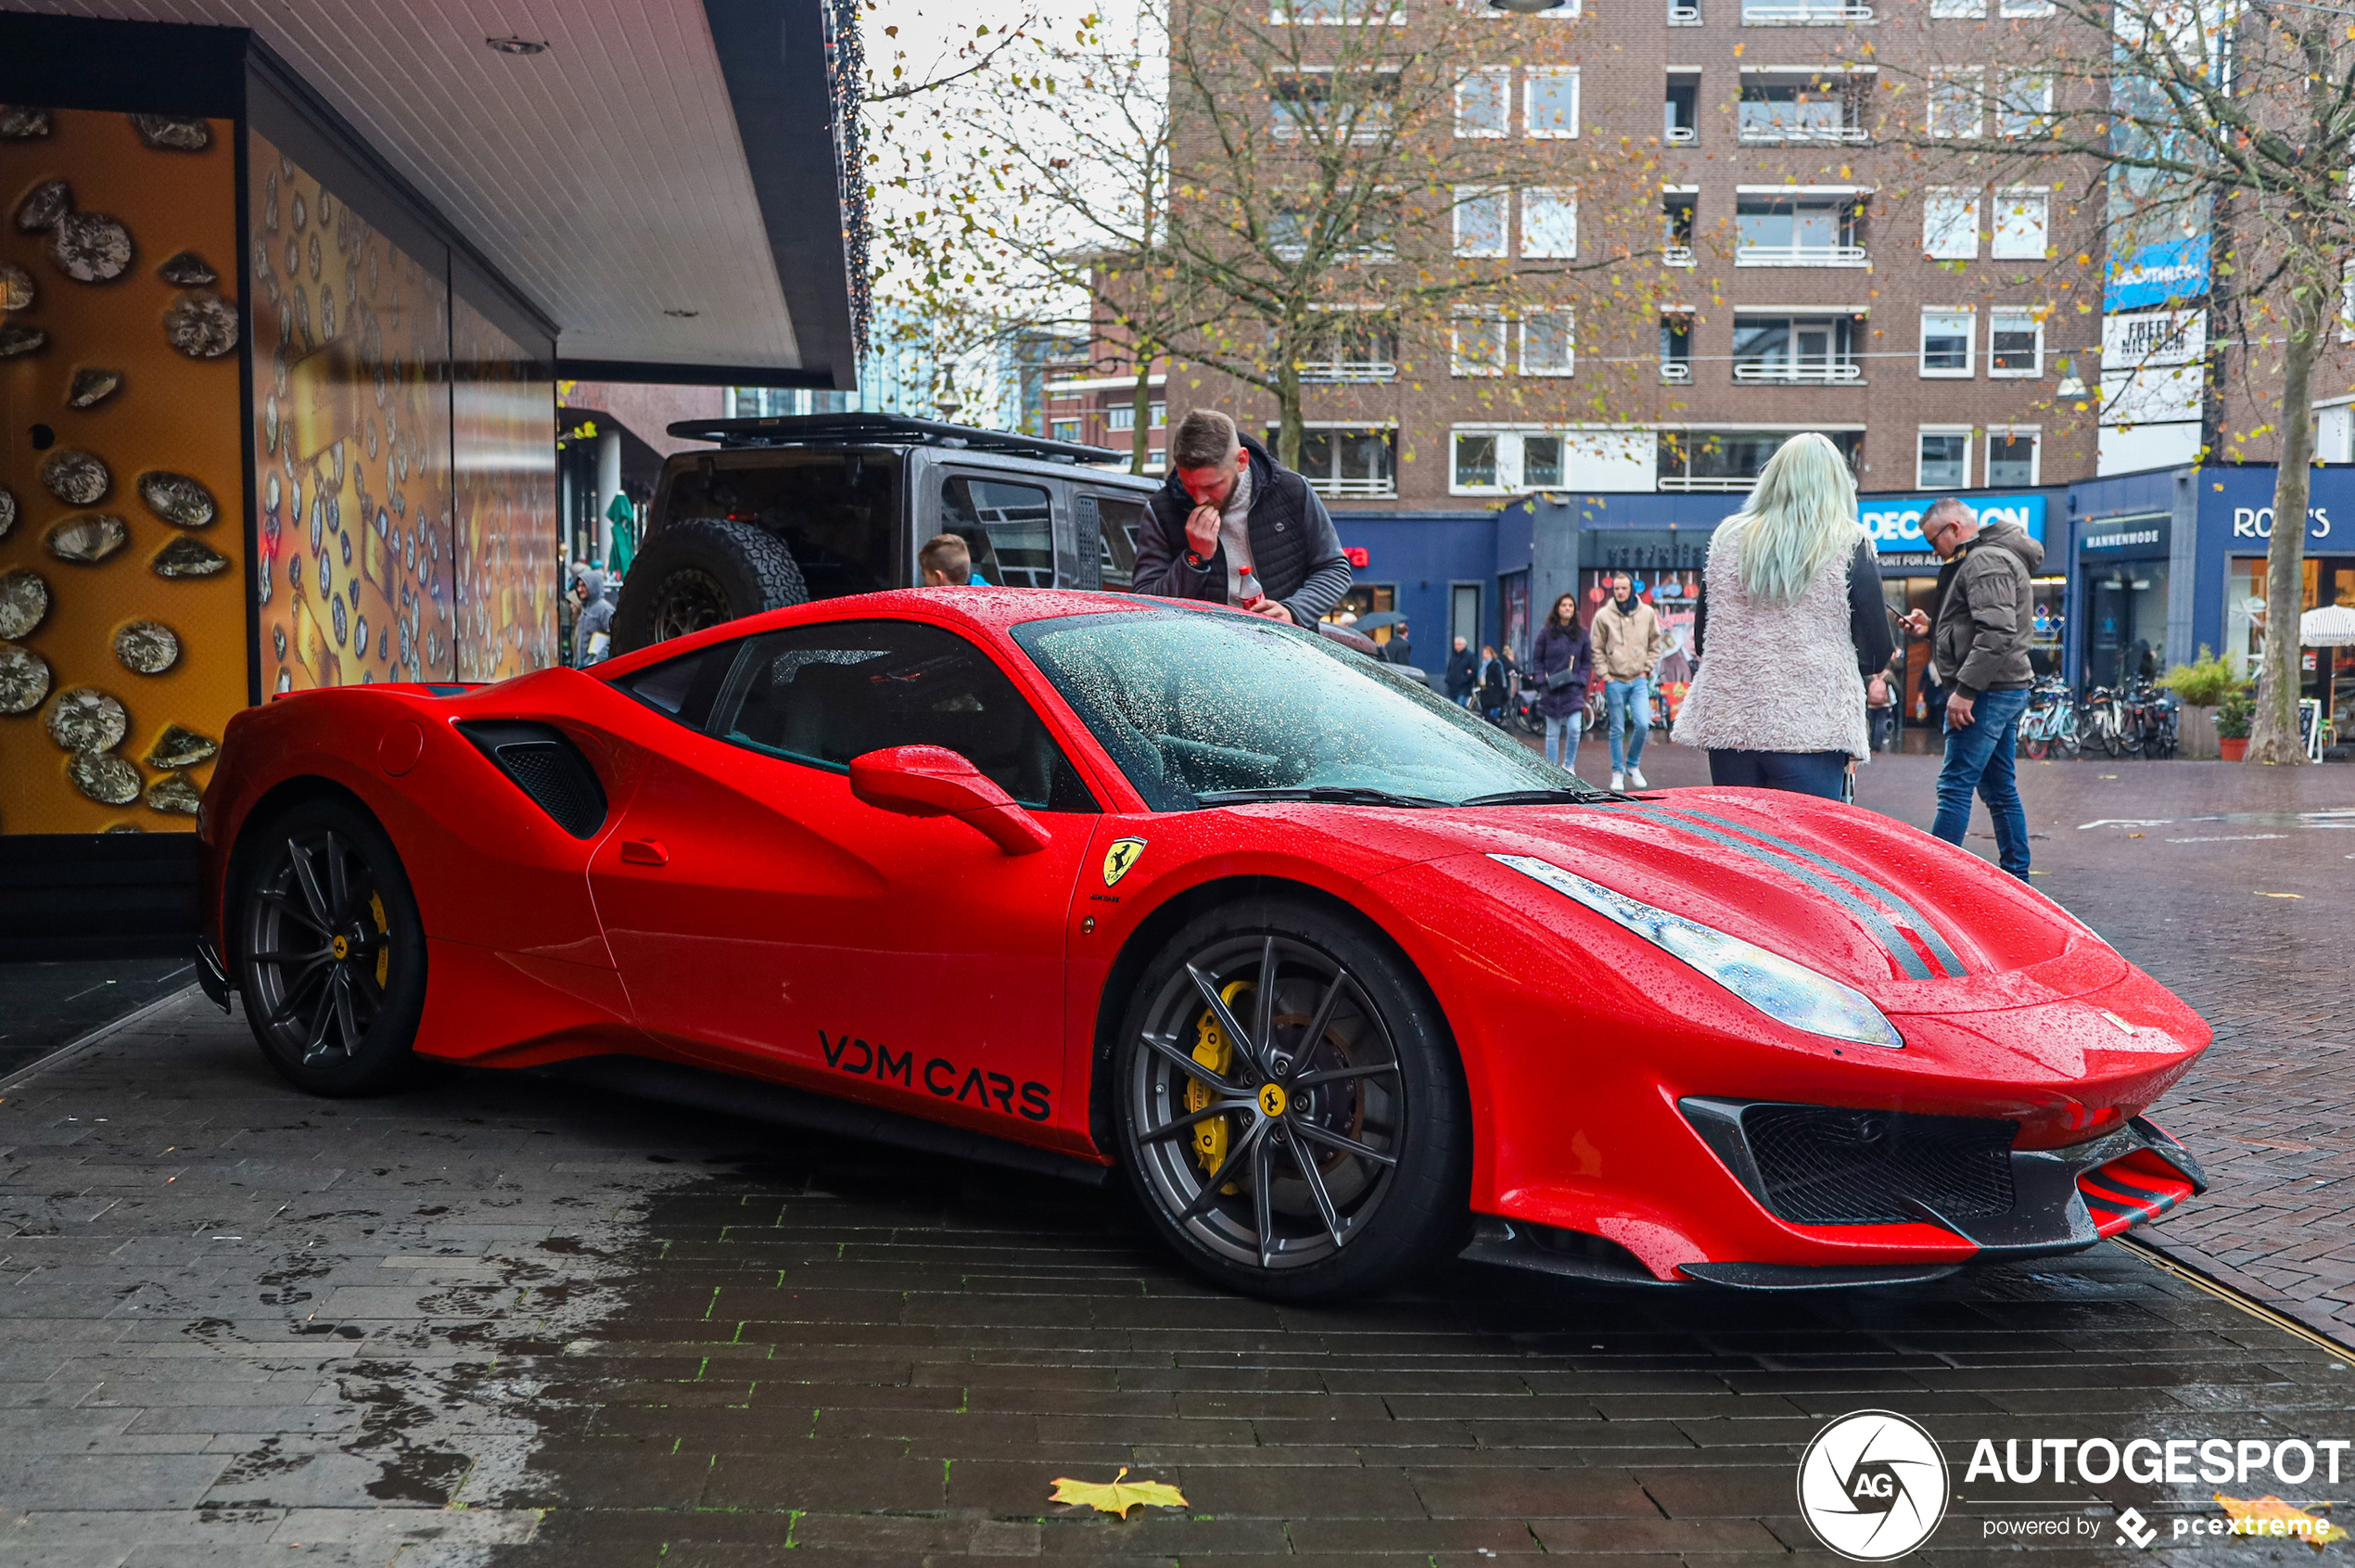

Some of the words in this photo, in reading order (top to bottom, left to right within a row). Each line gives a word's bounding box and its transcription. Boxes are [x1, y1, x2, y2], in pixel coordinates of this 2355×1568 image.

[1863, 507, 2030, 540] DECON
[2086, 529, 2160, 548] MANNENMODE
[1903, 555, 1924, 567] FOR
[818, 1029, 913, 1087] VDM
[923, 1057, 1051, 1122] CARS
